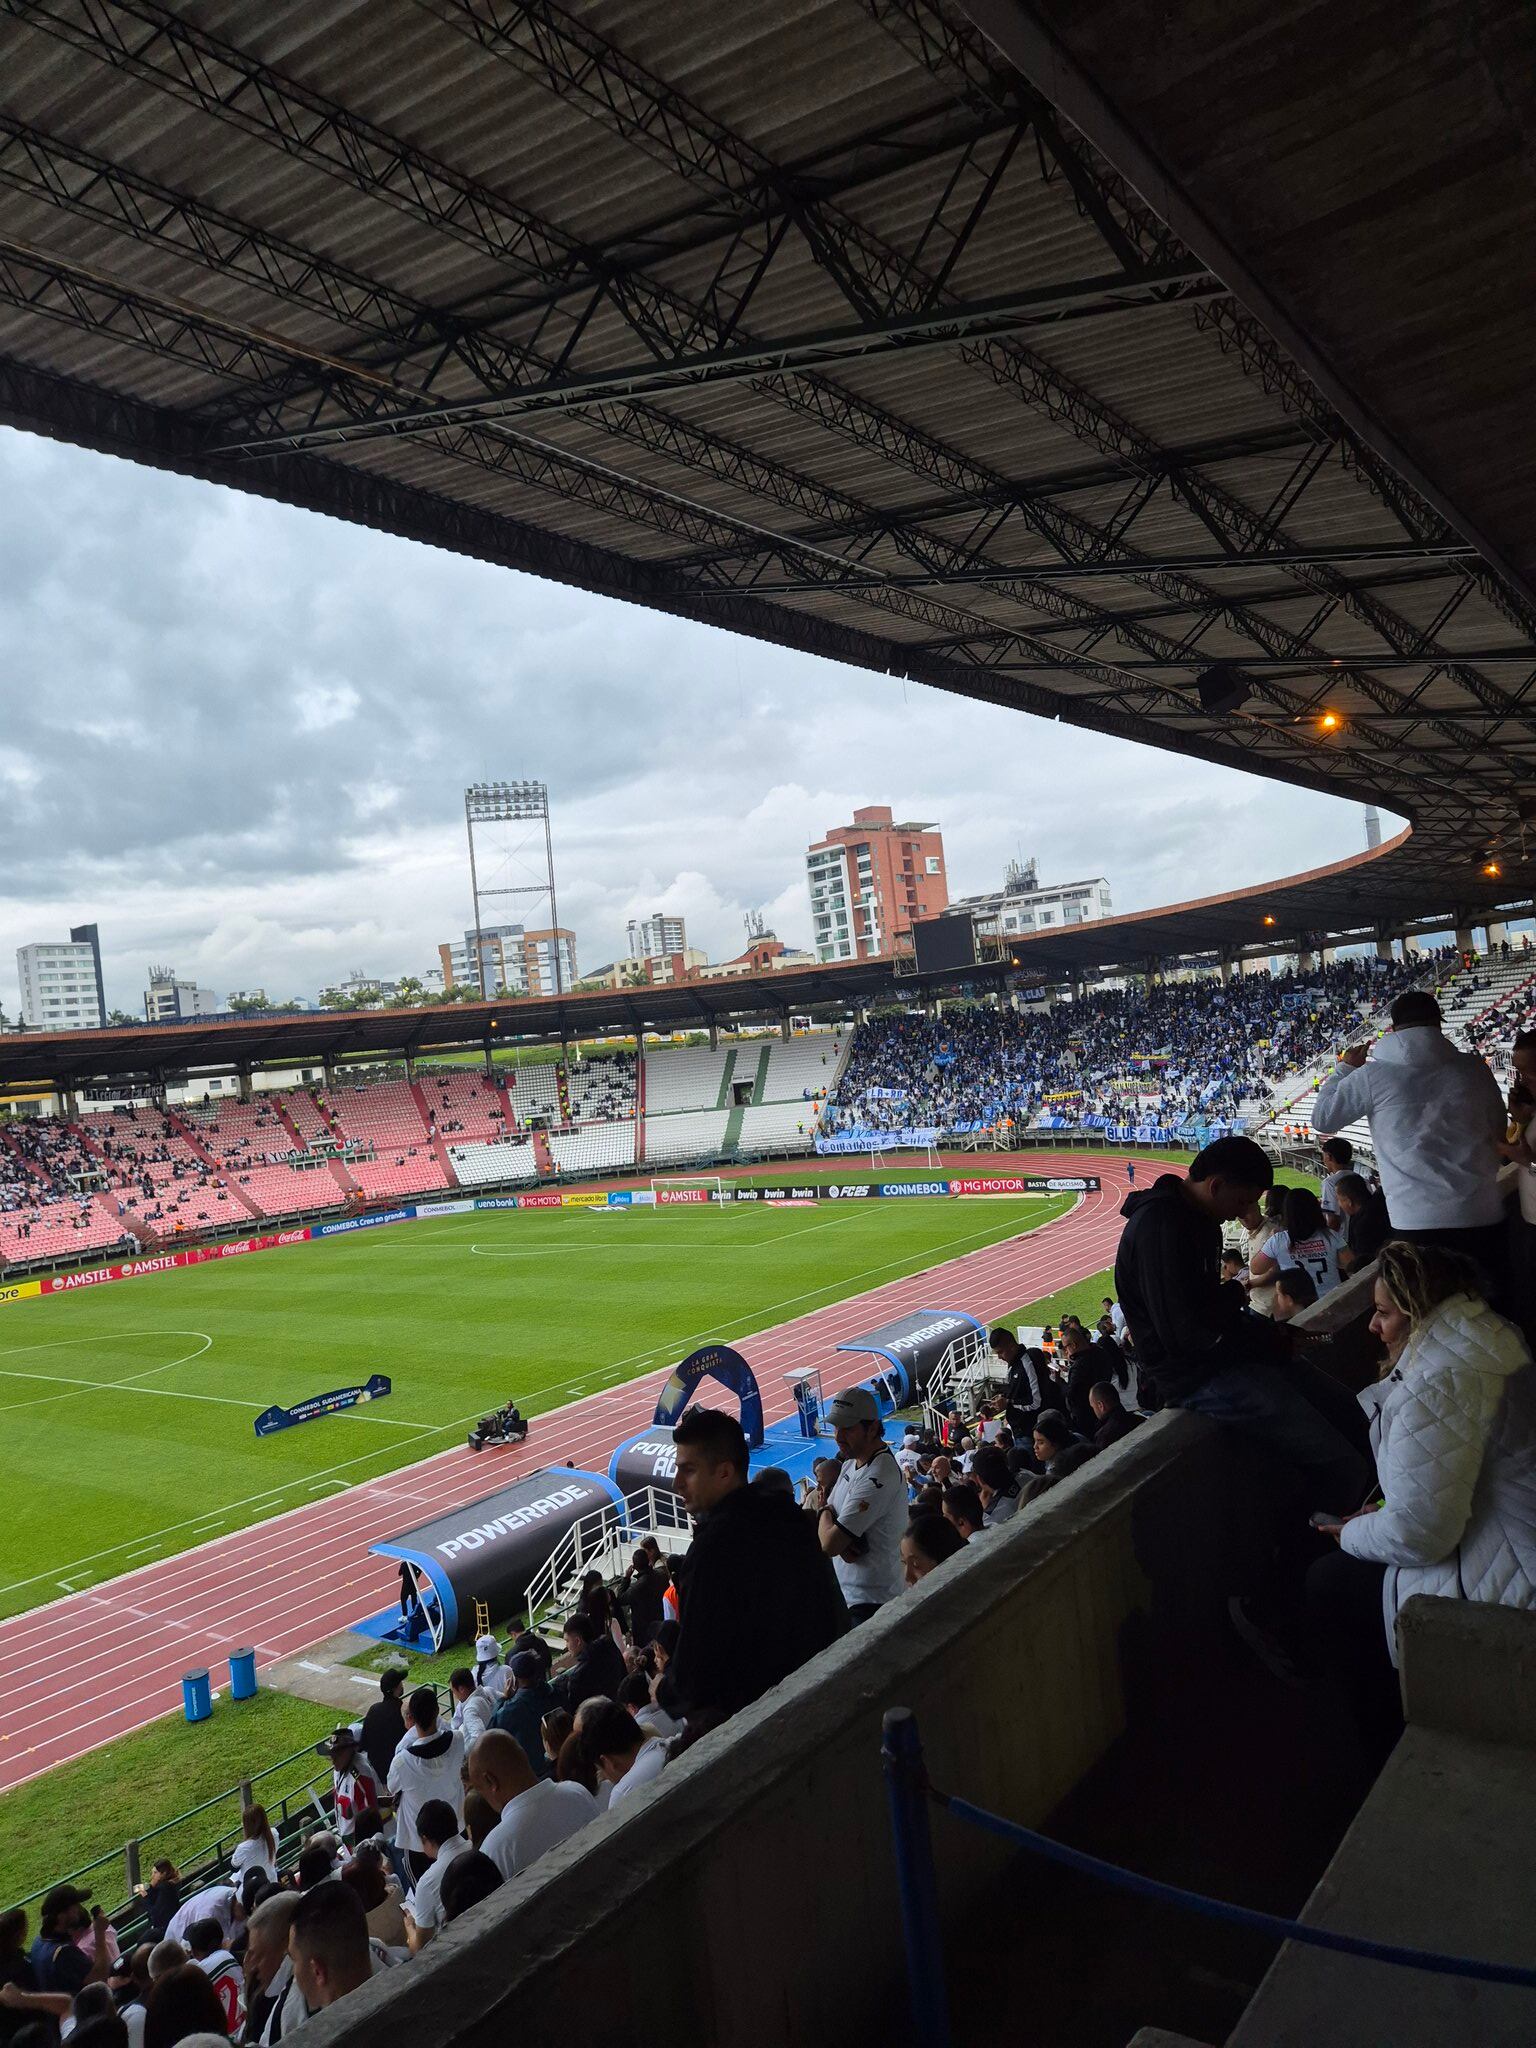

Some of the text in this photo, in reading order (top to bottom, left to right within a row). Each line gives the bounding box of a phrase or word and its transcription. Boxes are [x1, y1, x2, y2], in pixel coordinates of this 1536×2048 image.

[1107, 1126, 1137, 1140] BLUE
[882, 1182, 946, 1196] CONMEBOL
[963, 1179, 1023, 1191] MG MOTOR
[670, 1190, 702, 1201] AMSTEL
[764, 1188, 785, 1199] bwin
[791, 1187, 813, 1198] bwin
[539, 1195, 561, 1205] MOTOR
[322, 1219, 359, 1234] CONMEBOL
[133, 1255, 178, 1274] AMSTEL
[65, 1267, 113, 1289] AMSTEL
[884, 1317, 962, 1352] POWERADE
[436, 1484, 590, 1560] POWERADE
